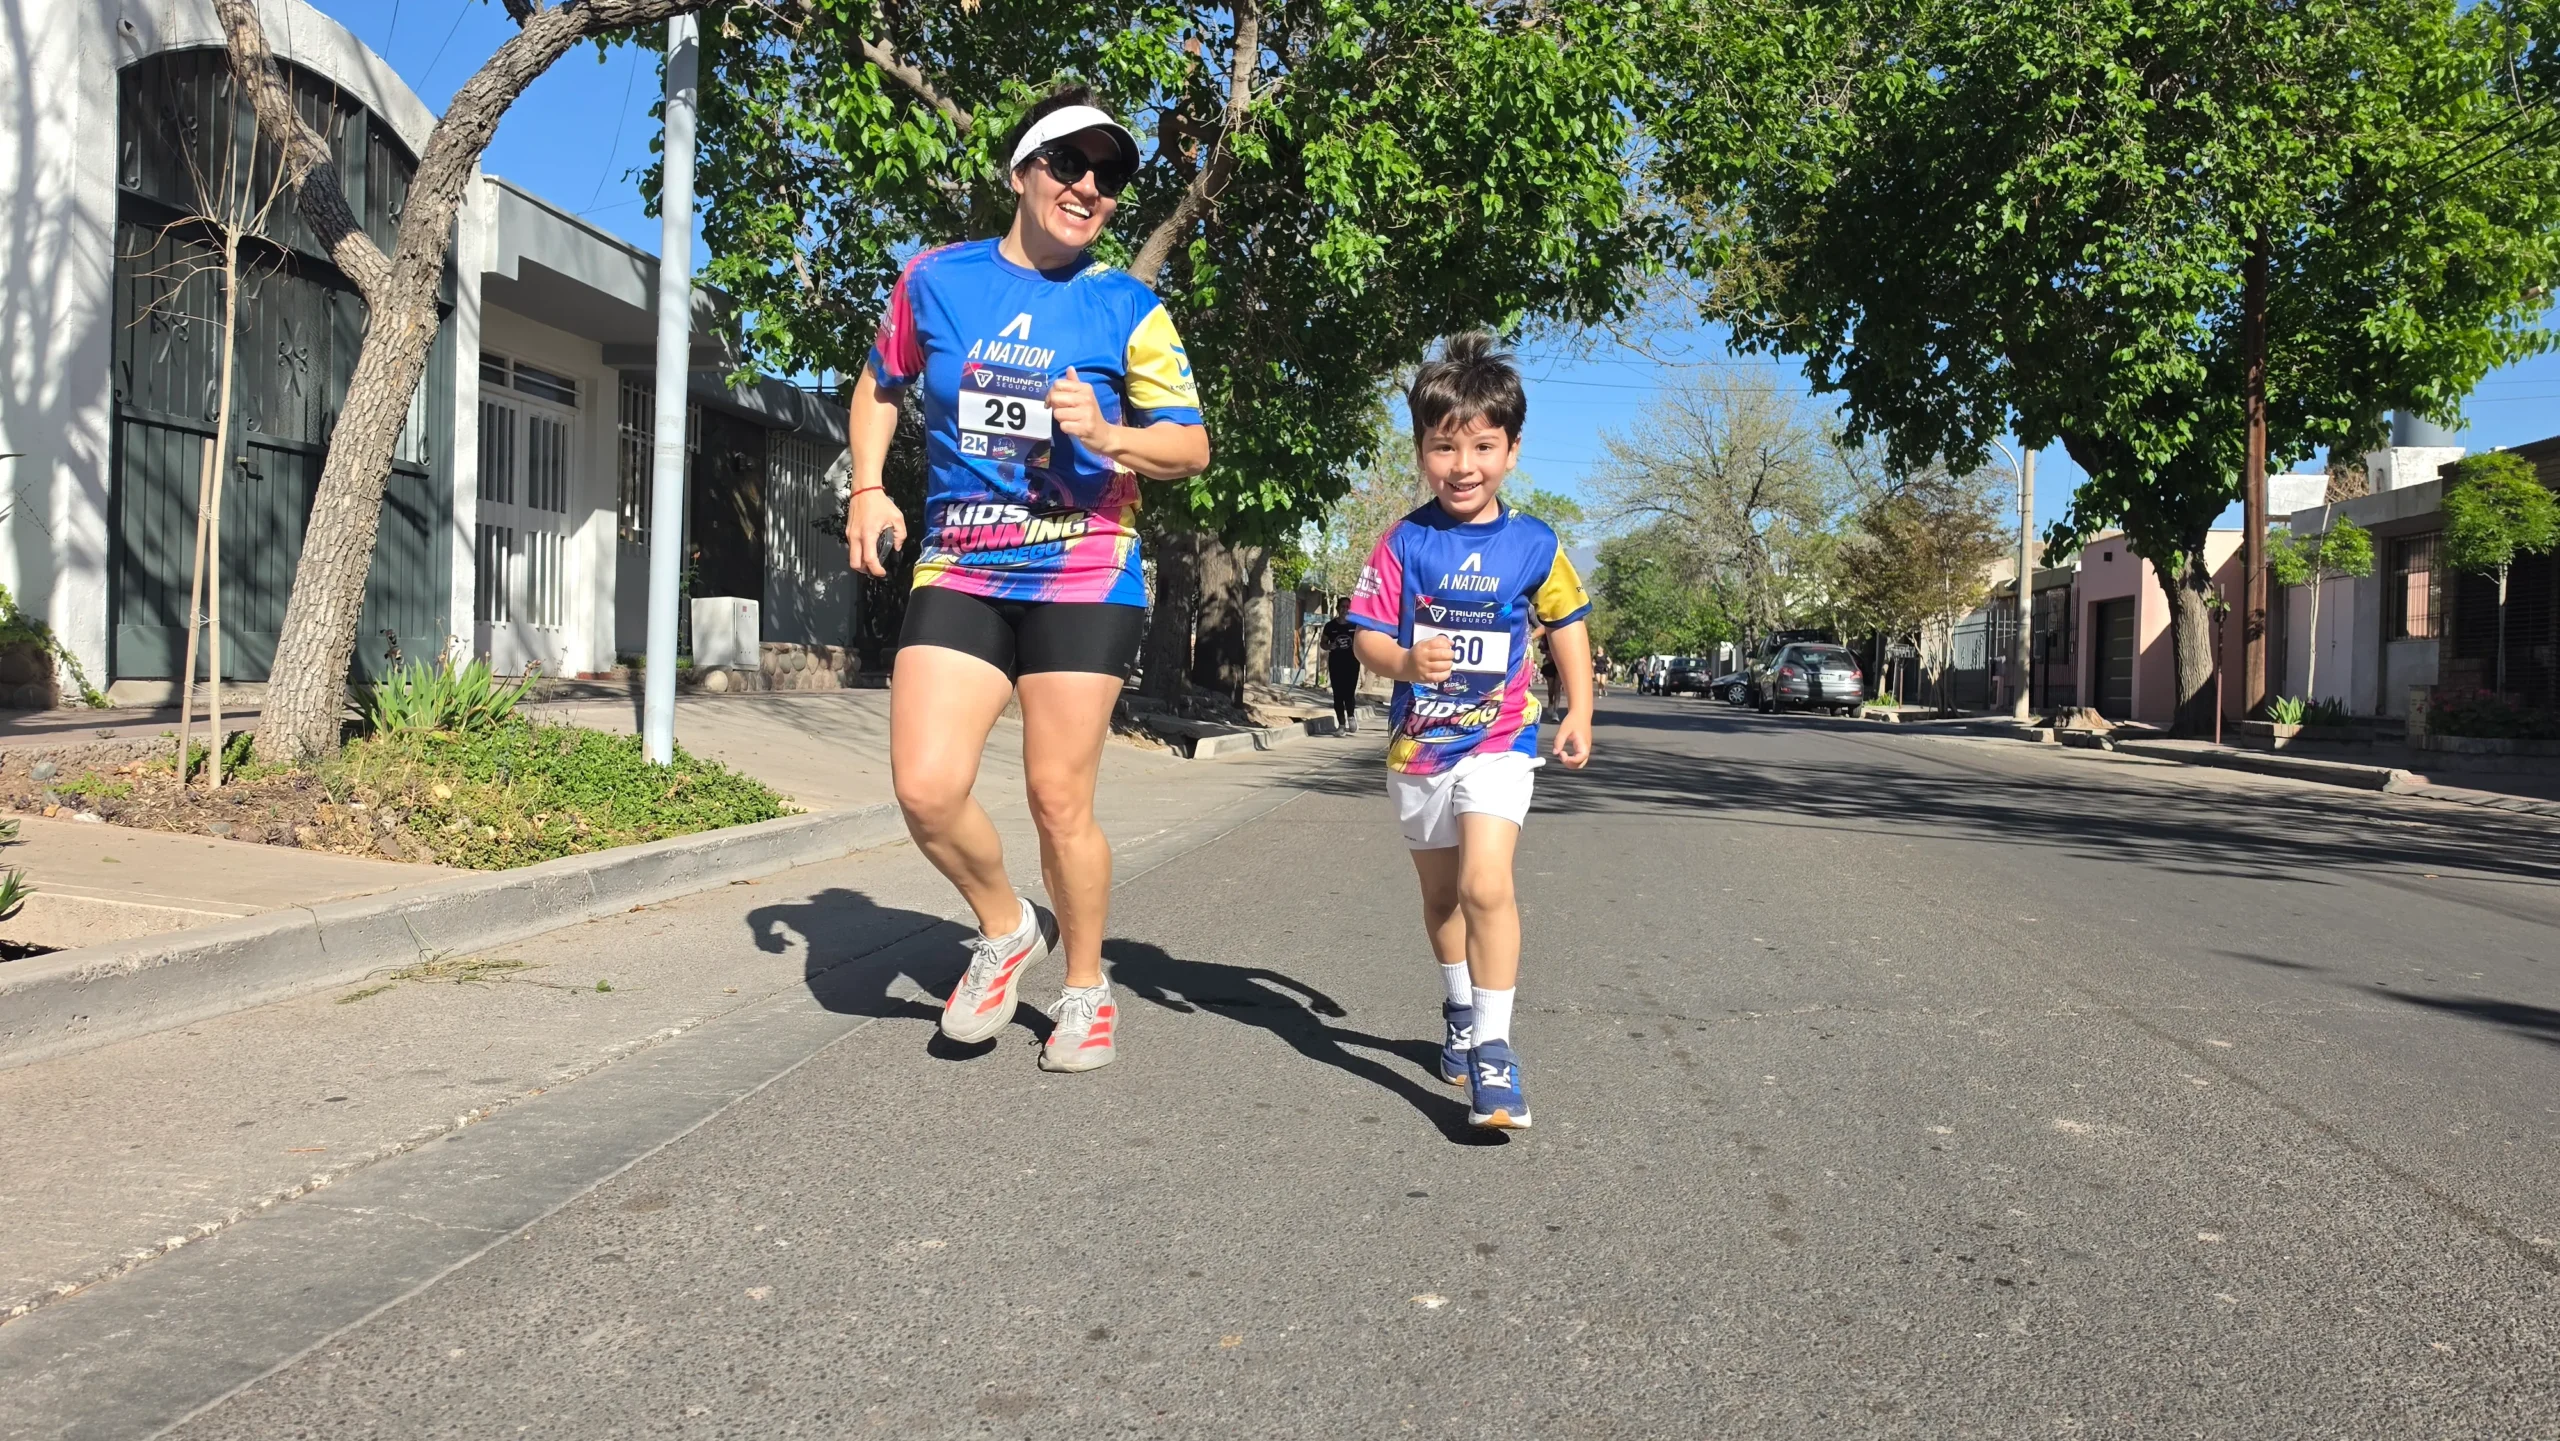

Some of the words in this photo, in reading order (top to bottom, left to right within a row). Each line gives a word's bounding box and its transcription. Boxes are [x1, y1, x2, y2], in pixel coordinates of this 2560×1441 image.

[967, 338, 983, 359] A
[982, 340, 1056, 370] NATION
[995, 374, 1043, 388] TRIUNFO
[996, 381, 1040, 393] SEGUROS
[984, 398, 1027, 431] 29
[945, 503, 1030, 526] KIDS
[940, 512, 1086, 554] RUNNING
[958, 541, 1062, 565] DORREGO
[1438, 573, 1449, 590] A
[1450, 574, 1500, 593] NATION
[1449, 609, 1495, 619] TRIUNFO
[1450, 617, 1493, 625] SEGUROS
[1437, 633, 1484, 666] 60
